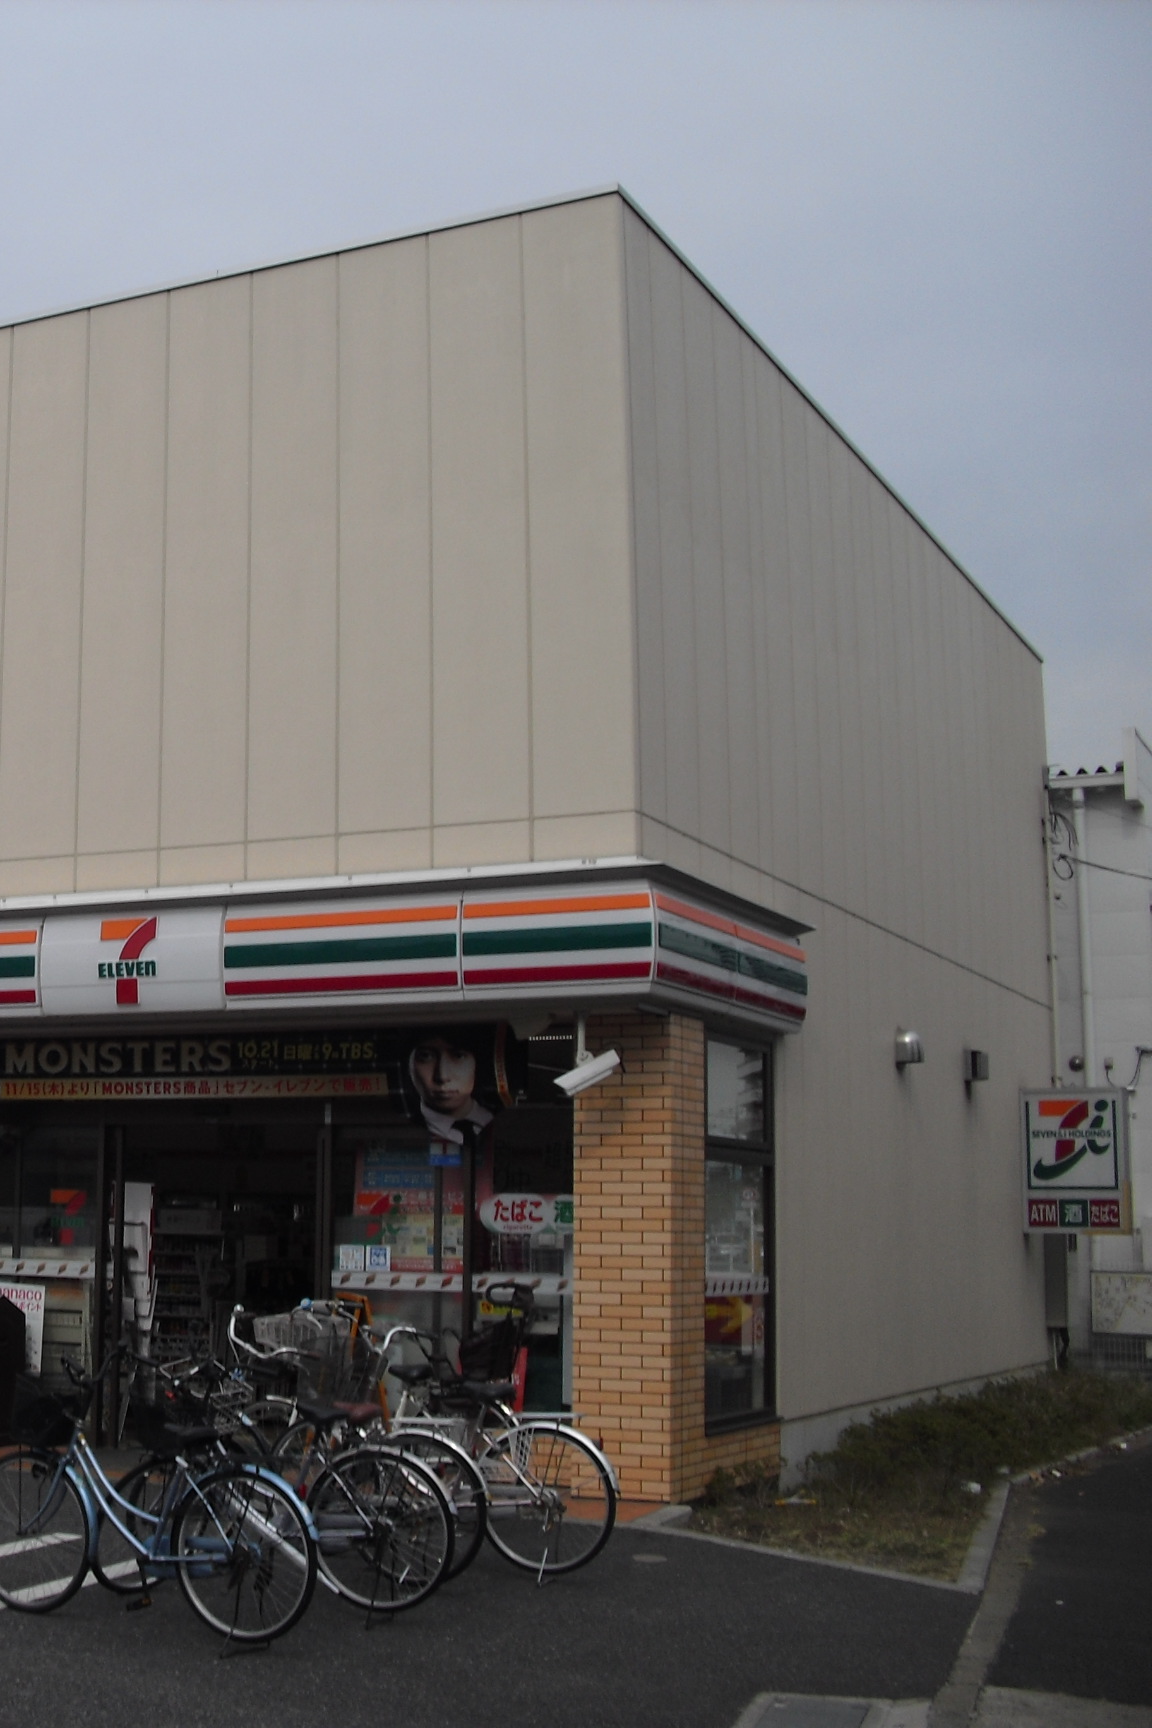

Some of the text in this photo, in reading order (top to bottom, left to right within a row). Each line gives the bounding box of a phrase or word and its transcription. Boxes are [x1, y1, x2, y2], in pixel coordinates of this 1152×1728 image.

[5, 1040, 232, 1075] MONSTERS
[237, 1041, 279, 1058] 10.21
[1068, 1129, 1111, 1139] HOLDINGS
[494, 1199, 543, 1223] たばこ
[1031, 1204, 1057, 1222] ATM
[1091, 1205, 1119, 1223] たばこ
